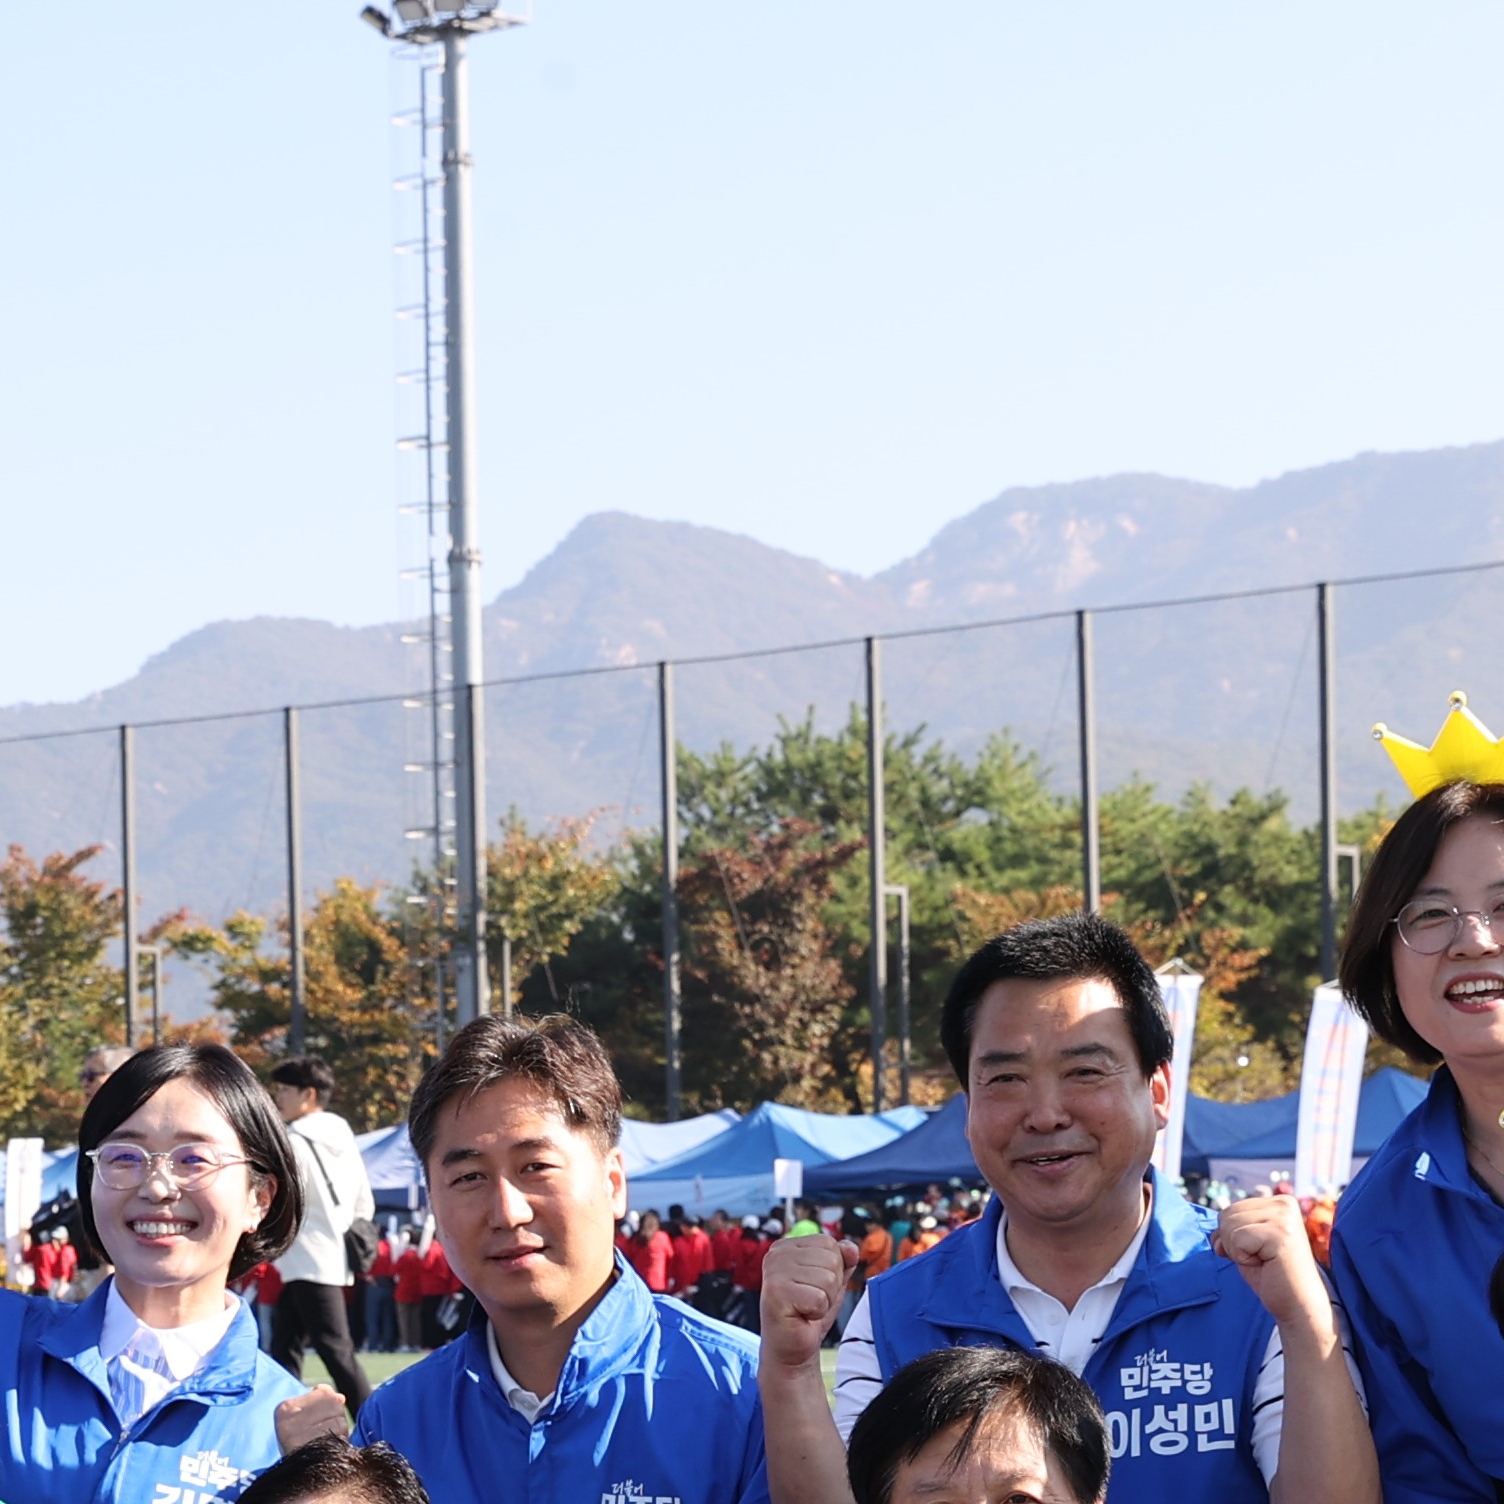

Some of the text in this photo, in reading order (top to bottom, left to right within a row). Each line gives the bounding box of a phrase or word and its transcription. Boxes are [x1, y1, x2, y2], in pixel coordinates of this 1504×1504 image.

[1133, 1347, 1168, 1367] 더불어
[1120, 1362, 1214, 1401] 민주당
[1104, 1398, 1236, 1459] 이성민
[611, 1478, 644, 1498] 더불어
